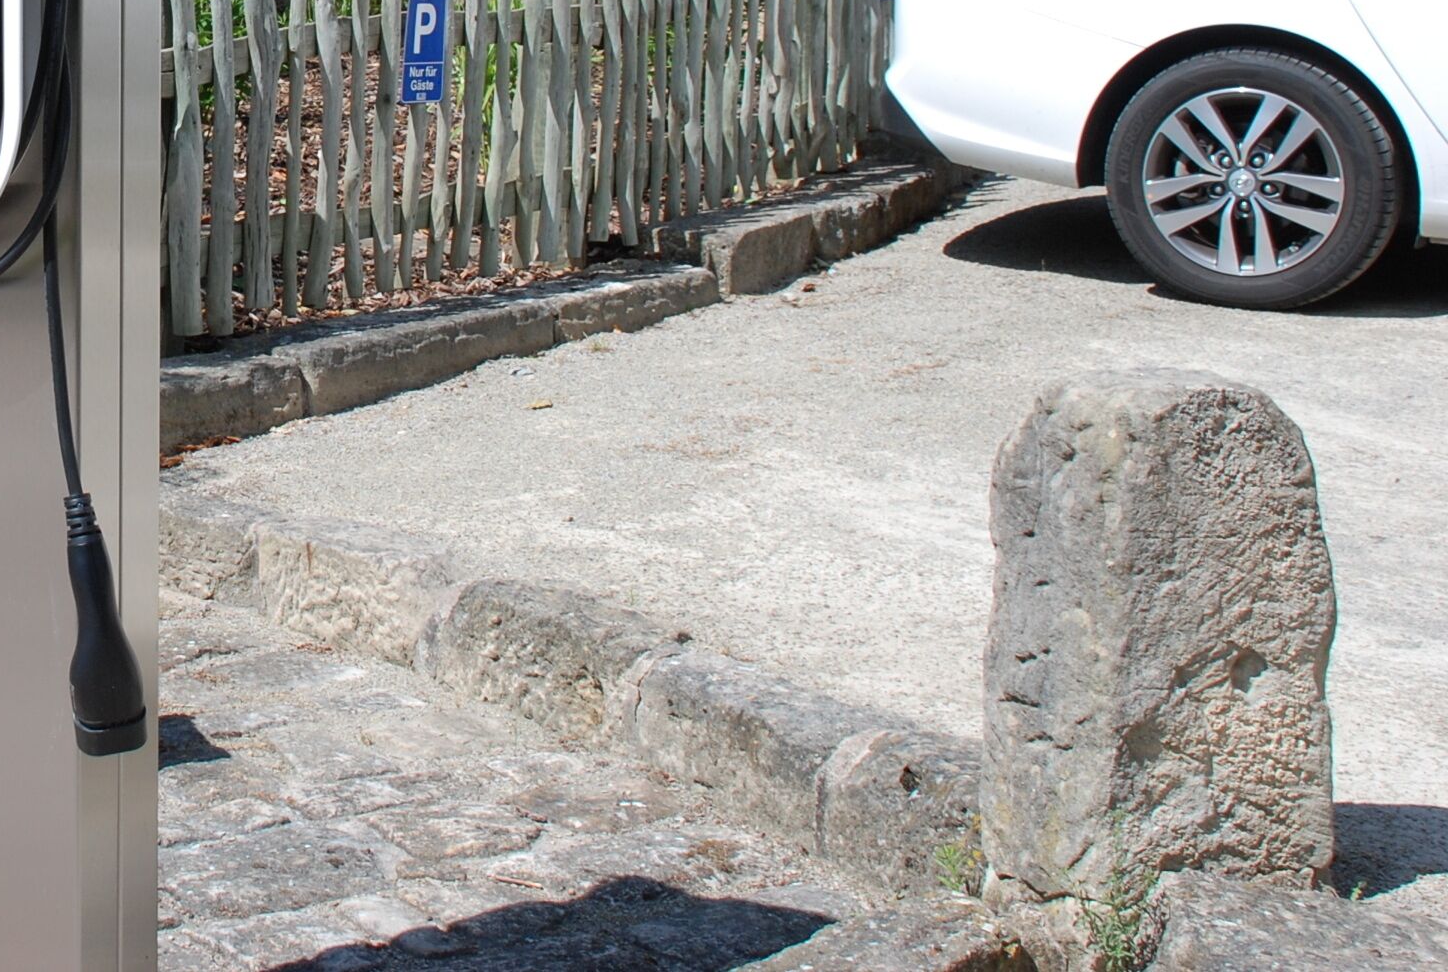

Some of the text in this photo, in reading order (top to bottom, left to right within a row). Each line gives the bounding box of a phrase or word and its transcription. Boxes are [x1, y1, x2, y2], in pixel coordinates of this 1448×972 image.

[413, 2, 437, 55] P
[409, 66, 438, 78] Nur für
[410, 80, 434, 91] Gäste
